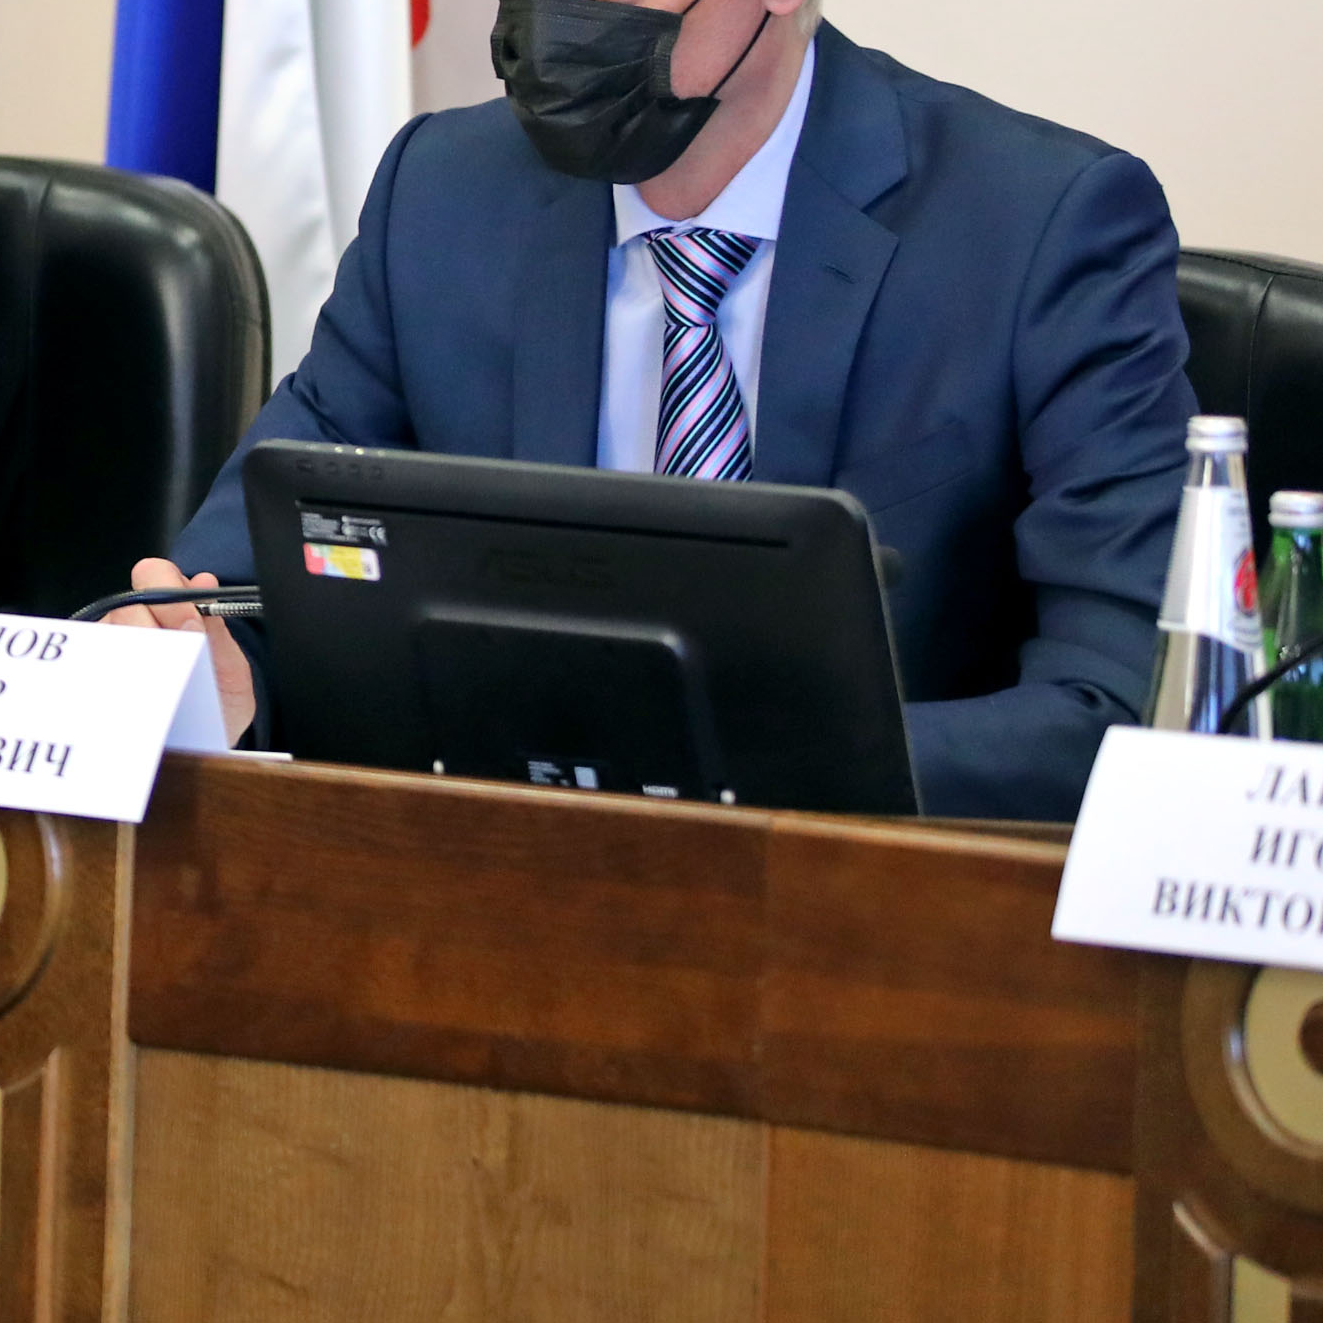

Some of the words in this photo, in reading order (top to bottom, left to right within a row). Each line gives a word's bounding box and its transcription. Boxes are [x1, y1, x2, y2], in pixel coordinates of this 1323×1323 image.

[1245, 763, 1323, 807] ЛА
[1250, 824, 1323, 869] ИГ
[1151, 877, 1323, 935] ВИКТО
